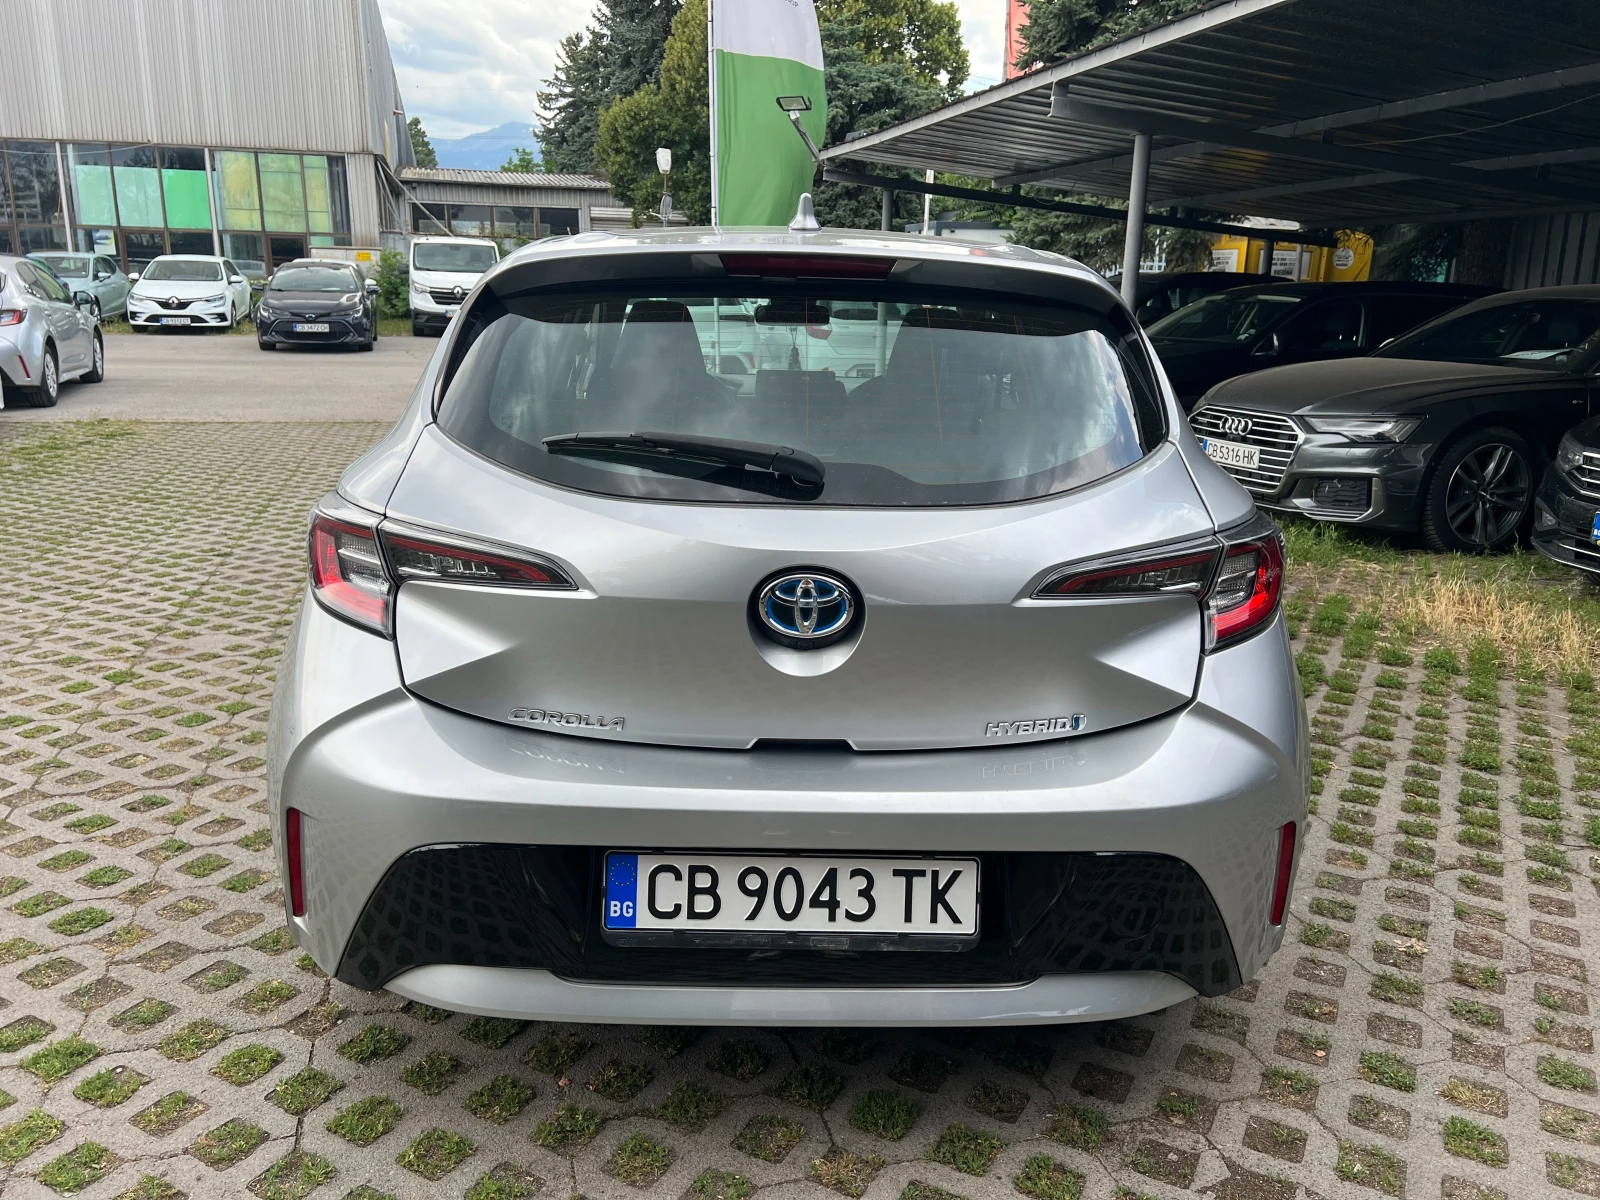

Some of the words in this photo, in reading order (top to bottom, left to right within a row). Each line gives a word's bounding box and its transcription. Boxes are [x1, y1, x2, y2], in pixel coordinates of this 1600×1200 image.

[1208, 443, 1218, 457] CB
[1219, 446, 1240, 462] 5316
[1242, 450, 1256, 465] HK
[508, 708, 625, 731] COROLLA
[985, 718, 1070, 737] HYBRID
[647, 863, 722, 921] CB
[737, 866, 877, 923] 9043
[892, 868, 964, 925] TK
[609, 900, 634, 918] BG
